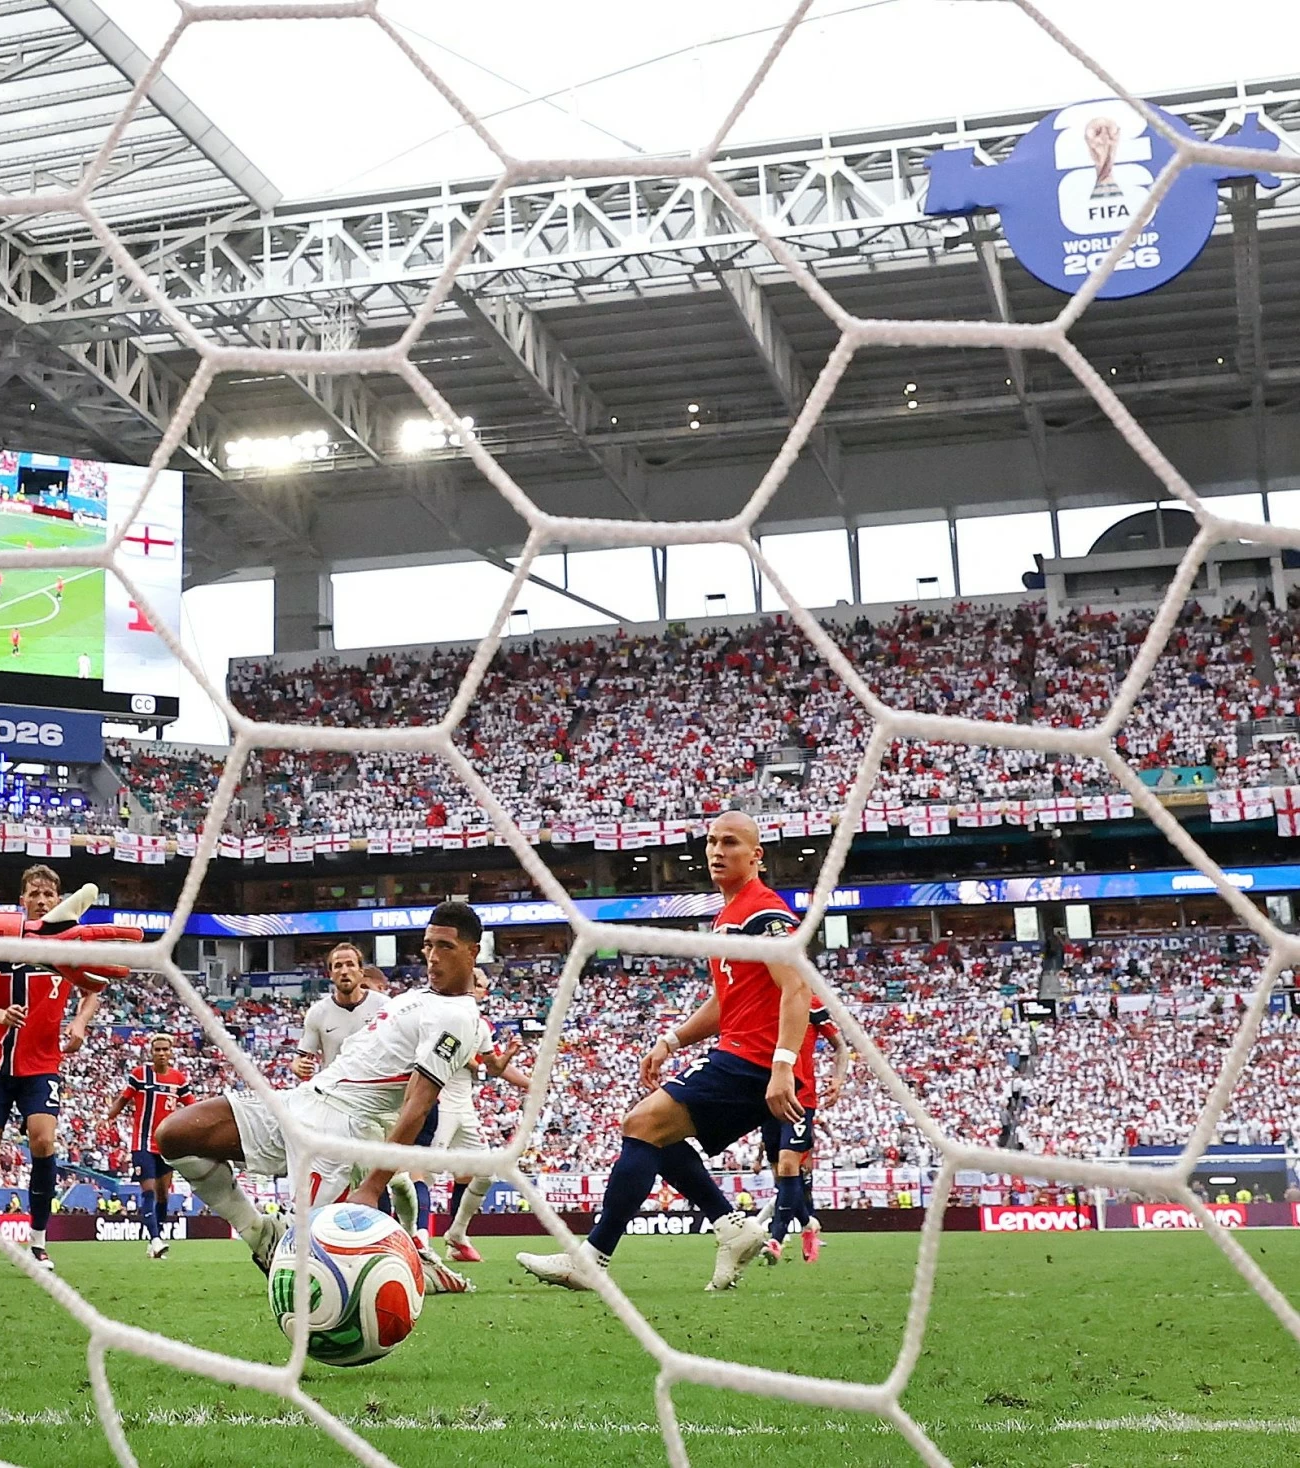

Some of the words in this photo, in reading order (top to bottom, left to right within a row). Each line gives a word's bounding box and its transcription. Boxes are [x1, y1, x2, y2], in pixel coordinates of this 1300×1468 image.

[1088, 204, 1130, 220] FIFA
[1128, 232, 1159, 248] UP
[1063, 246, 1161, 276] 2026
[135, 698, 152, 710] CC
[794, 889, 861, 909] MAMI
[113, 911, 171, 930] MIAMI
[372, 911, 410, 928] FIFA
[48, 975, 63, 1000] 8
[495, 1190, 522, 1206] FIF
[547, 1192, 576, 1204] STILL
[95, 1216, 140, 1241] Smarter
[172, 1216, 187, 1240] all
[626, 1212, 694, 1235] arter
[983, 1207, 1086, 1232] Lenovo
